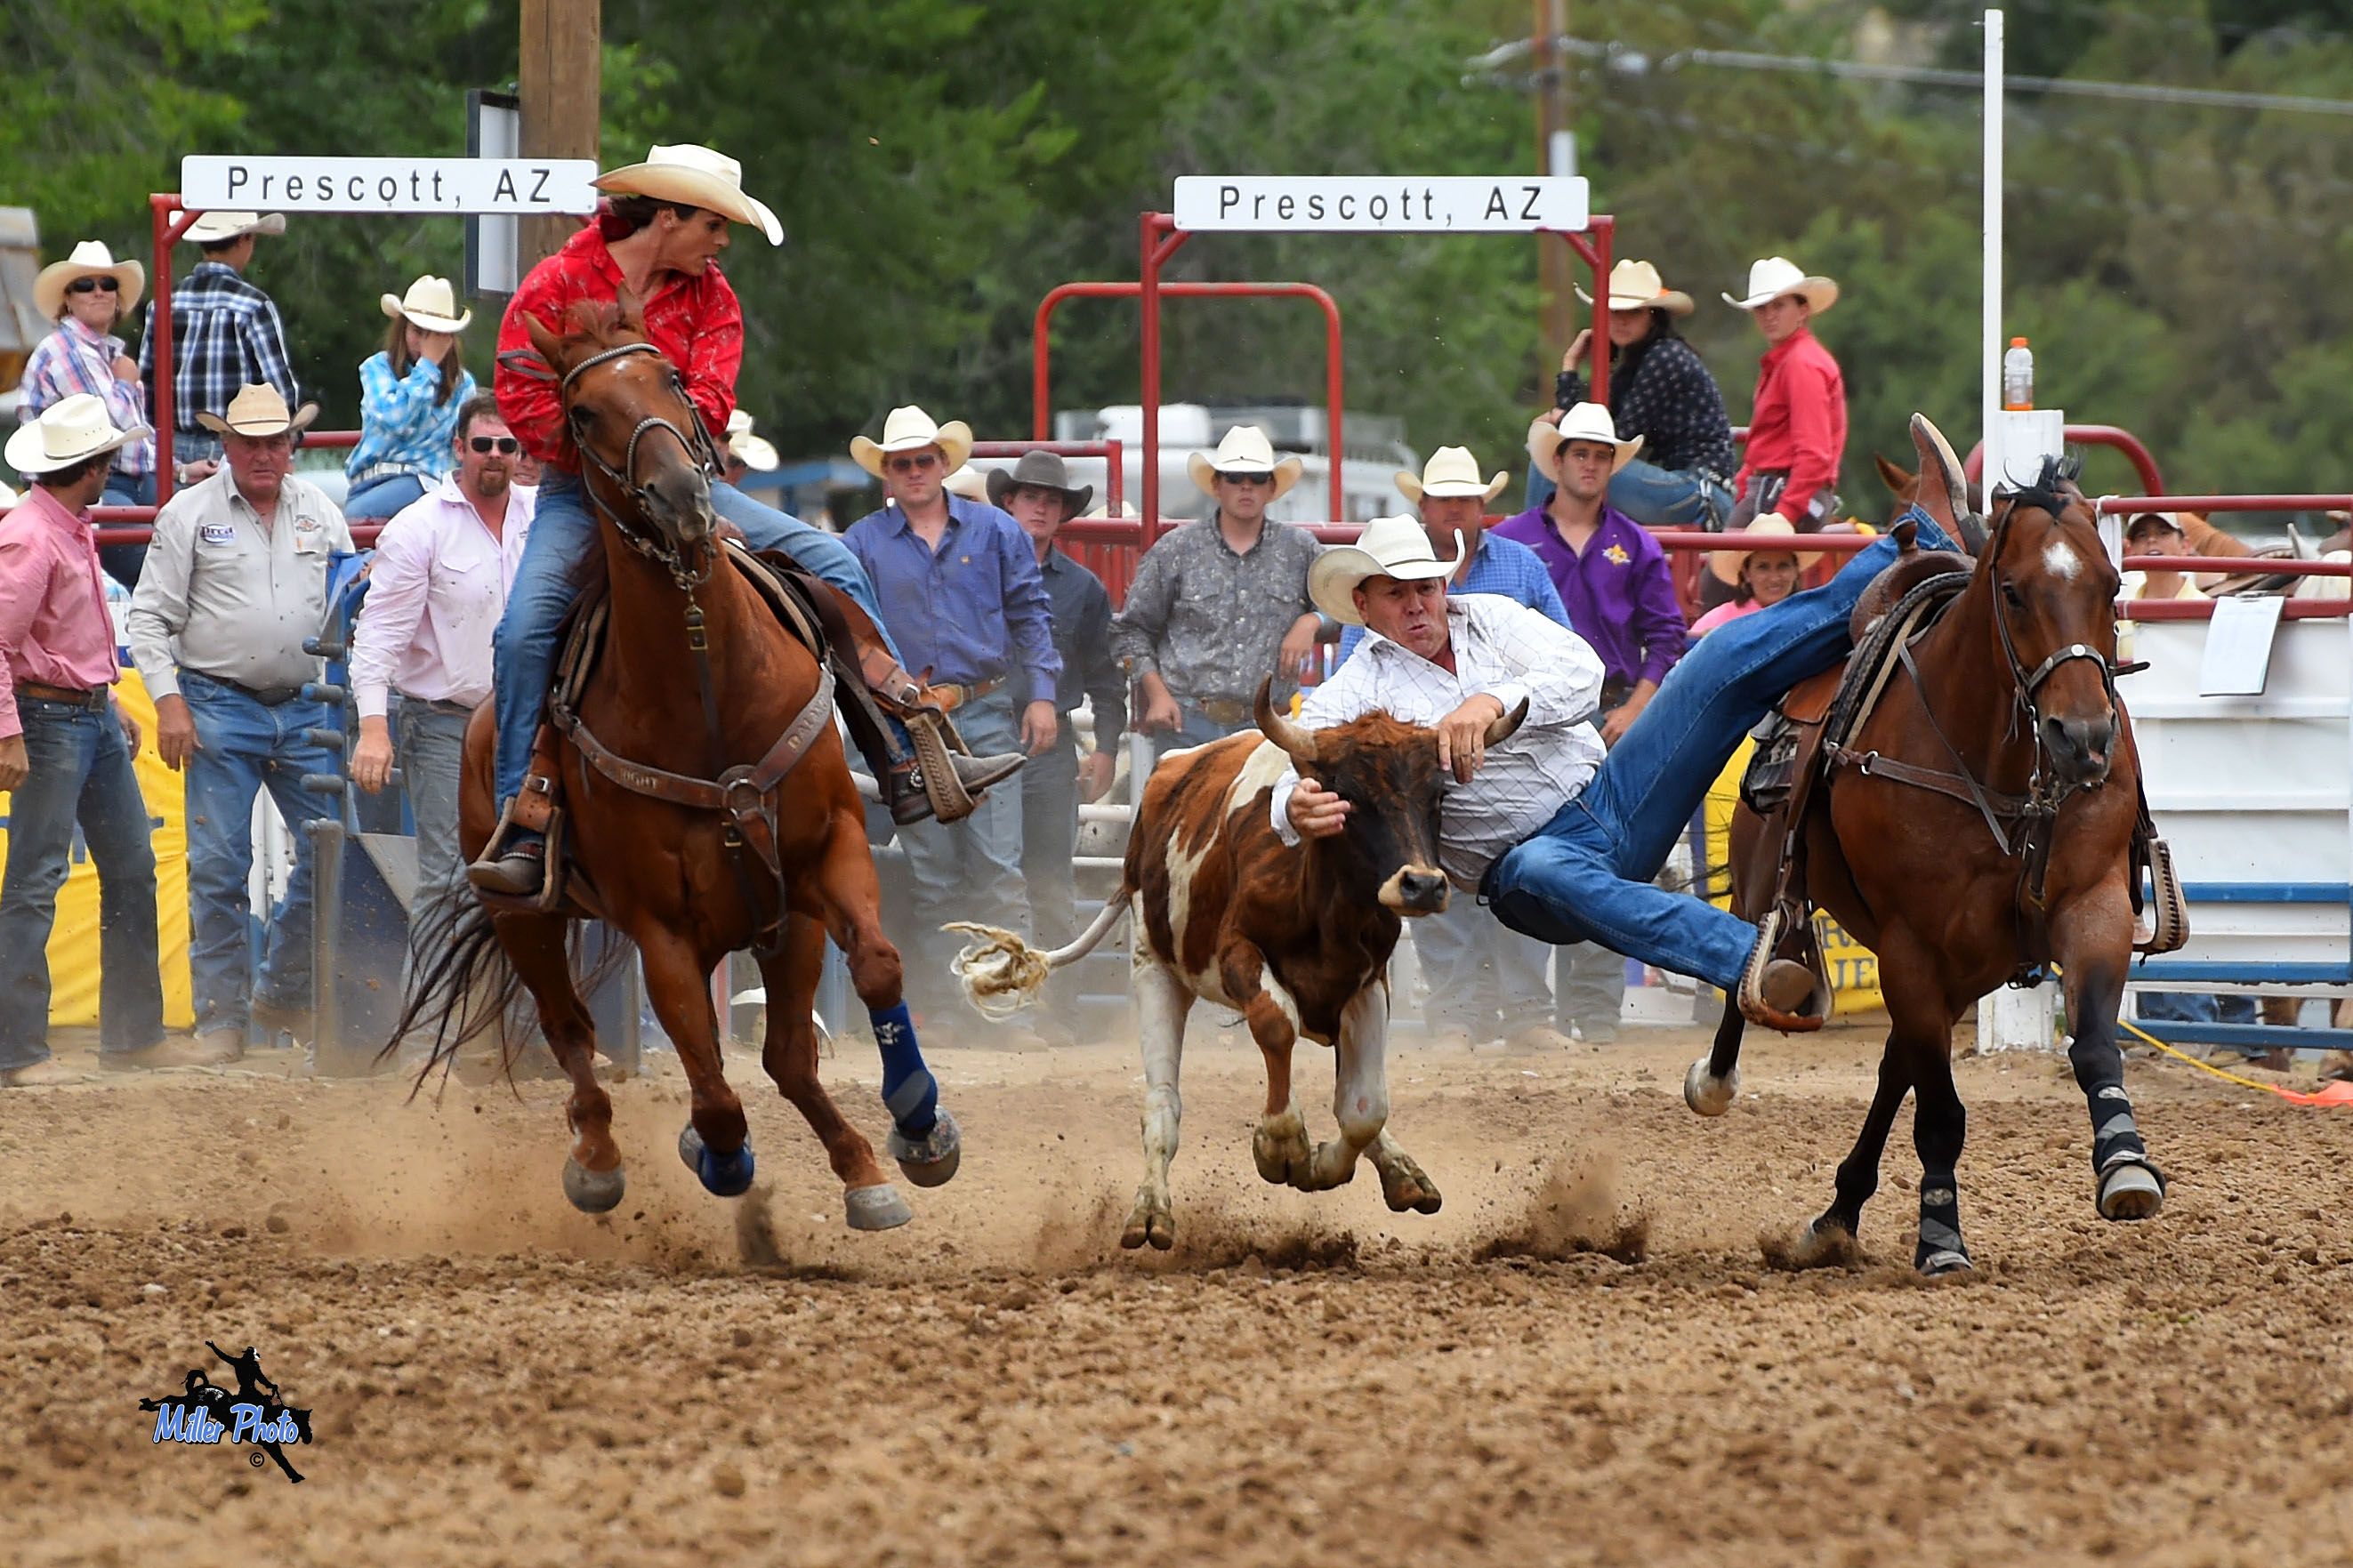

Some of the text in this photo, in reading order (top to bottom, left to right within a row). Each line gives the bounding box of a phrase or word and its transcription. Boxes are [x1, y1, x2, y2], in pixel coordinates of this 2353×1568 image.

[227, 165, 551, 209] Prescott, AZ
[1219, 185, 1542, 227] Prescott, AZ
